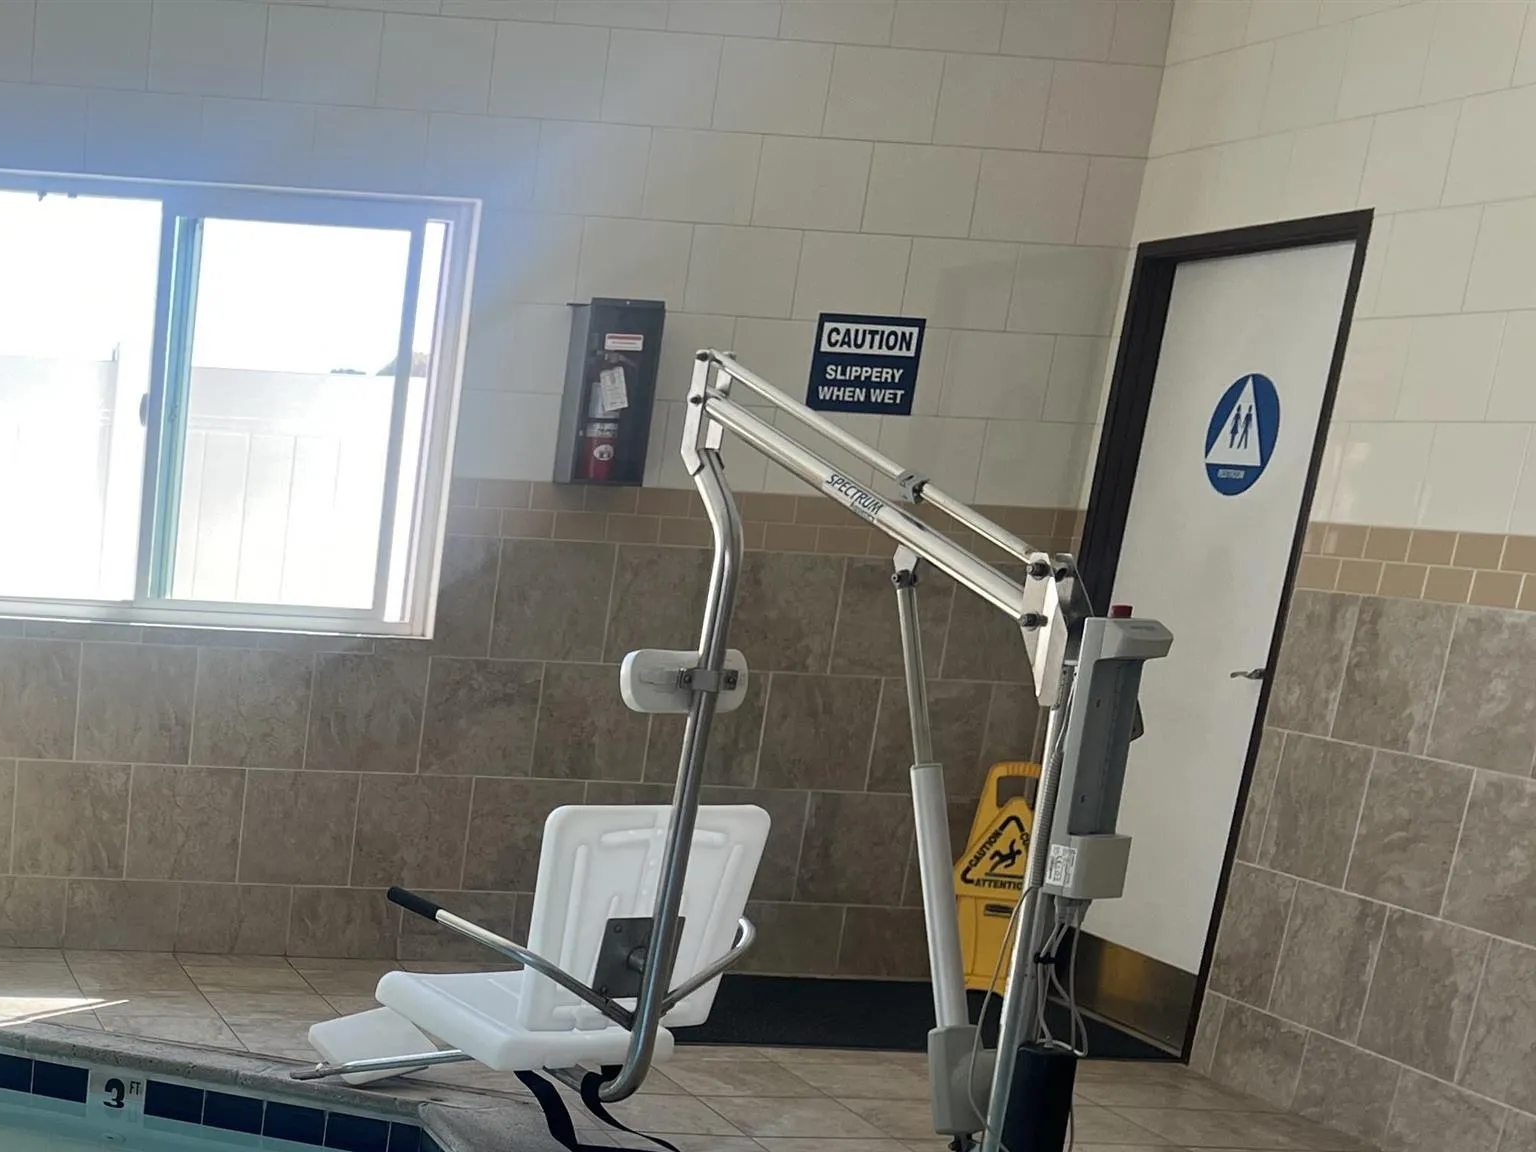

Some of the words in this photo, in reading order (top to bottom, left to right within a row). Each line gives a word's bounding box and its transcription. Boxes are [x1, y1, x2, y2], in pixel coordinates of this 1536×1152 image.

[827, 327, 913, 351] CAUTION
[825, 365, 903, 383] SLIPPERY
[818, 386, 866, 402] WHEN
[870, 388, 905, 404] WET
[826, 474, 884, 515] SPECTRUM
[969, 828, 1002, 867] CAUTION
[974, 878, 1023, 891] ATTENTIO
[103, 1078, 125, 1109] 3
[129, 1081, 141, 1096] FT
